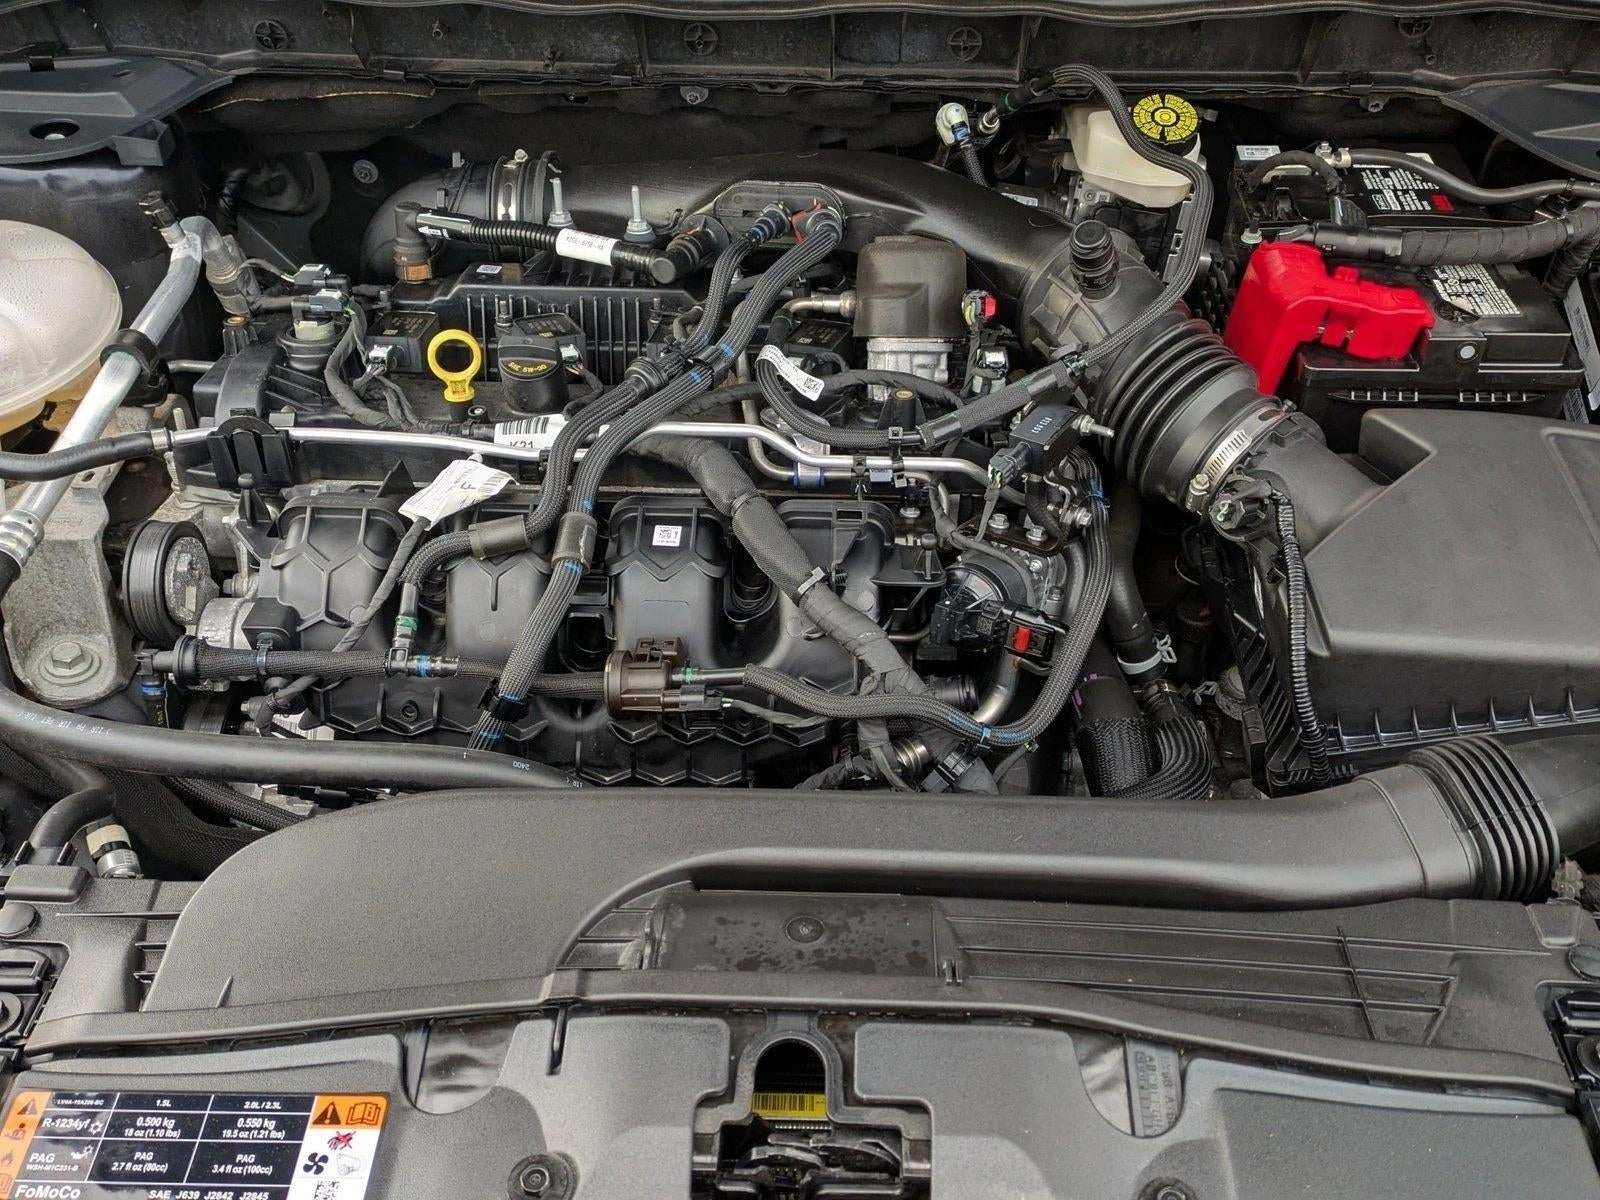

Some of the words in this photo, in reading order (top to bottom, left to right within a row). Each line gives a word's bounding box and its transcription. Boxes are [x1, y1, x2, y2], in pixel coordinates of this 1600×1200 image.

[512, 760, 530, 771] 2400
[156, 1099, 172, 1107] 1.5L
[244, 1101, 261, 1109] 2.0L
[42, 1117, 91, 1130] R-1234yf
[136, 1117, 162, 1127] 0.500
[162, 1117, 176, 1129] kg
[237, 1117, 263, 1128] 0.550
[263, 1118, 277, 1130] kg
[124, 1128, 134, 1137] 18
[145, 1128, 165, 1138] (1.10
[165, 1129, 181, 1139] lbs)
[222, 1129, 239, 1138] 19.5
[249, 1130, 269, 1139] (1.21
[269, 1130, 286, 1140] lbs)
[29, 1152, 56, 1163] PAG
[134, 1151, 154, 1161] PAG
[236, 1154, 256, 1163] PAG
[111, 1161, 126, 1171] 2.7
[125, 1161, 133, 1171] fl
[143, 1163, 168, 1173] (80cc)
[212, 1164, 226, 1174] 3.4
[225, 1164, 233, 1174] fl
[232, 1166, 243, 1174] oz
[243, 1165, 273, 1176] (100cc)
[15, 1184, 81, 1199] FoMoCo
[149, 1189, 172, 1199] SAE
[175, 1190, 200, 1200] J639
[203, 1191, 234, 1200] J2842
[239, 1191, 269, 1200] J2845
